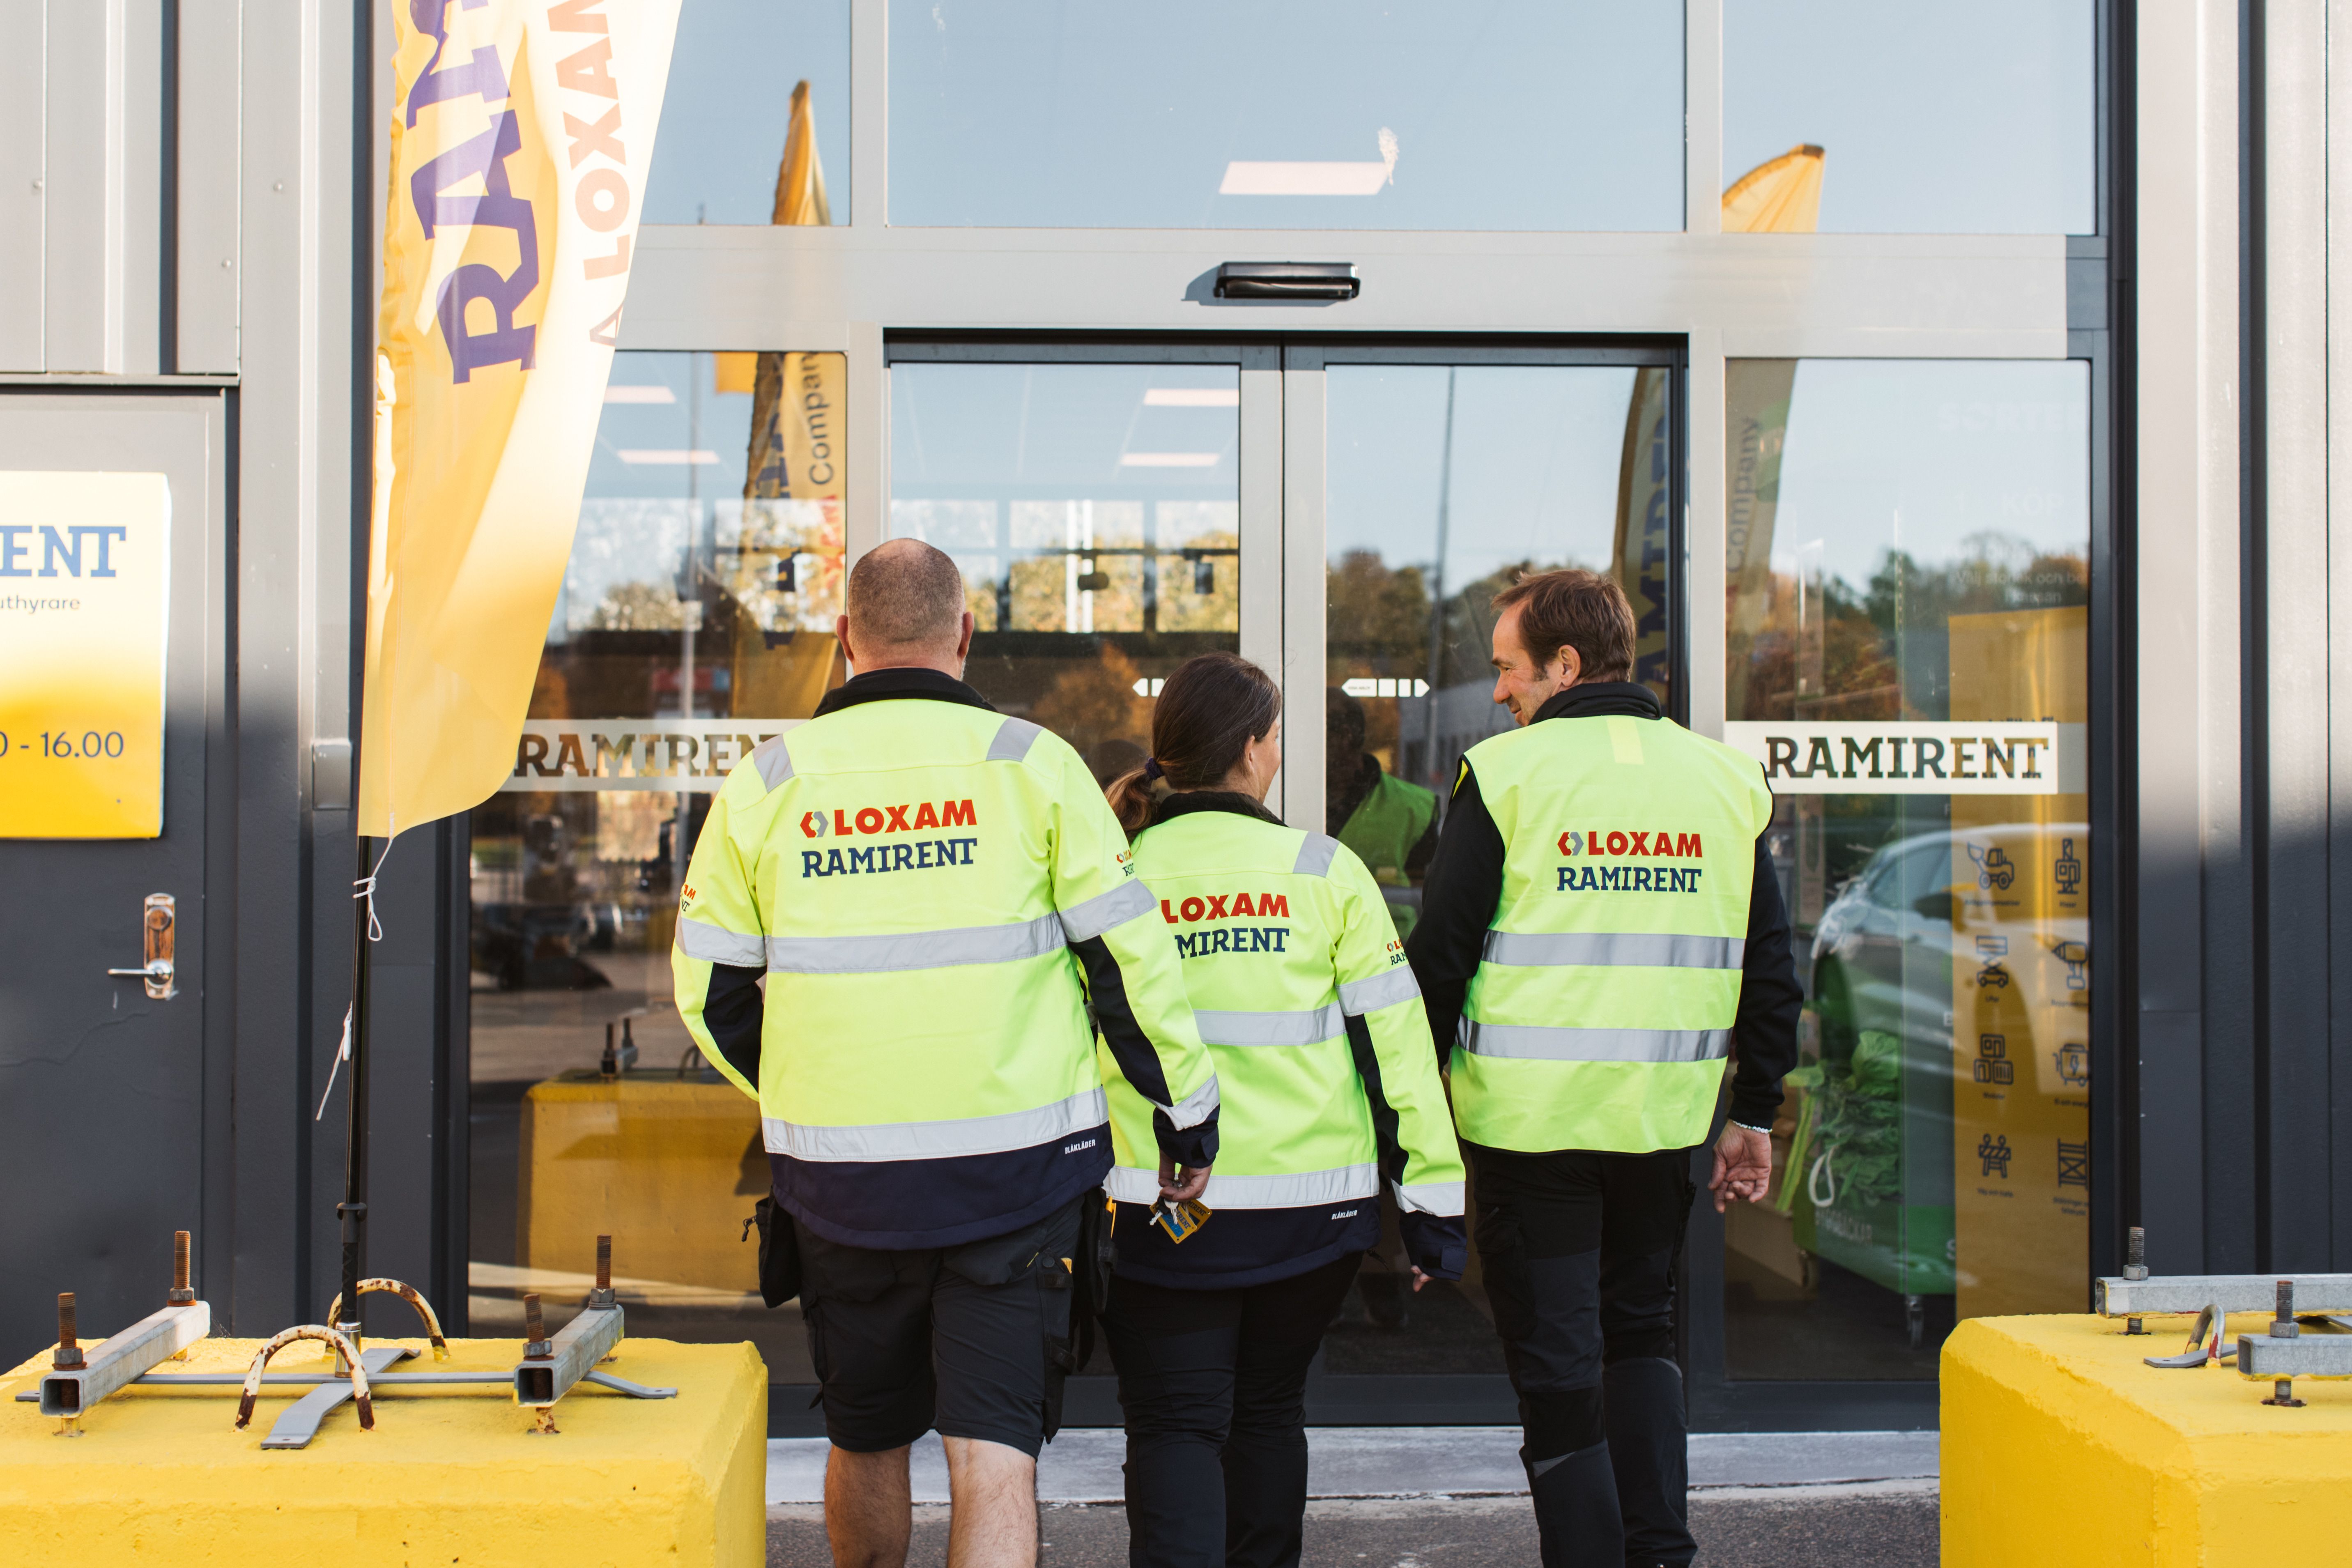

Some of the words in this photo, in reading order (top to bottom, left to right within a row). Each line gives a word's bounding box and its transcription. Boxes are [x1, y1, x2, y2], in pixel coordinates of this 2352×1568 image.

[0, 526, 126, 577] ENT
[40, 731, 124, 757] 16.00
[514, 733, 783, 777] RAMIRE
[1766, 737, 2049, 779] RAMIRENT
[834, 799, 977, 836] LOXAM
[801, 838, 977, 878] RAMIRENT
[1588, 831, 1703, 858] LOXAM
[1557, 866, 1702, 893] RAMIRENT
[1161, 892, 1290, 924] LOXAM
[1064, 1139, 1096, 1154] BLÅKLÄDER
[1331, 1209, 1358, 1220] BLÅKLÄDER
